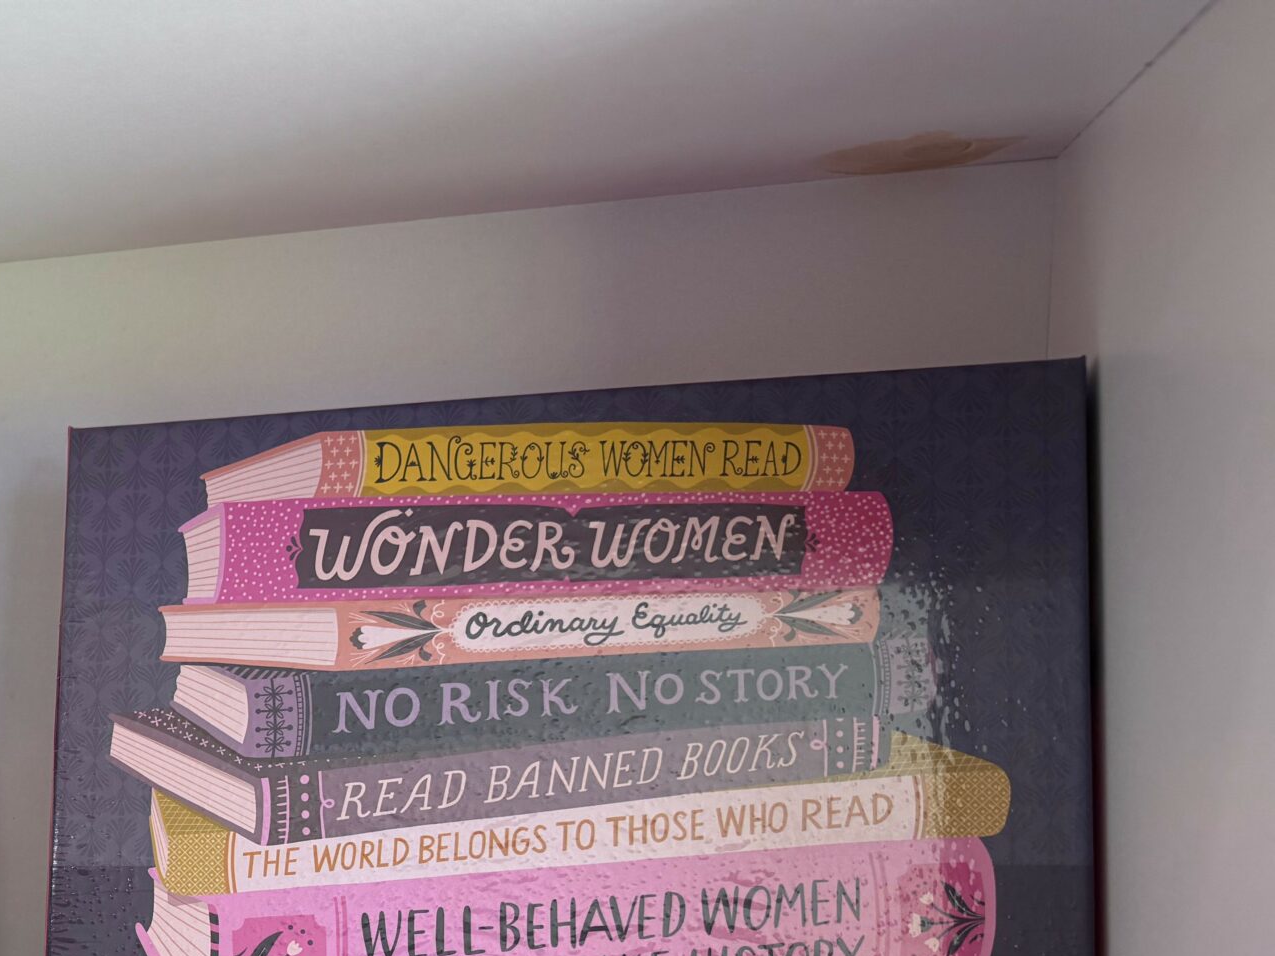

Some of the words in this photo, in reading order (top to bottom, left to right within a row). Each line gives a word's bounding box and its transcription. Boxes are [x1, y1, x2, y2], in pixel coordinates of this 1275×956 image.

[373, 435, 591, 486] DANGEROUS
[600, 438, 716, 481] WOMEN
[720, 438, 802, 479] READ
[308, 508, 575, 583] WONDER
[589, 512, 799, 569] WOMEN
[465, 608, 625, 646] Ordinary
[631, 601, 748, 638] Equality
[332, 687, 422, 735] NO
[437, 677, 579, 726] RISK
[694, 662, 848, 706] STORY
[336, 770, 467, 822] READ
[482, 746, 663, 804] BANNED
[676, 729, 806, 784] BOOKS
[243, 847, 301, 880] THE
[311, 832, 410, 876] WORLD
[417, 821, 547, 866] BELONGS
[555, 819, 598, 851] TO
[610, 805, 705, 845] THOSE
[714, 800, 791, 836] WHO
[801, 793, 895, 830] READ
[701, 876, 863, 929] WOMEN
